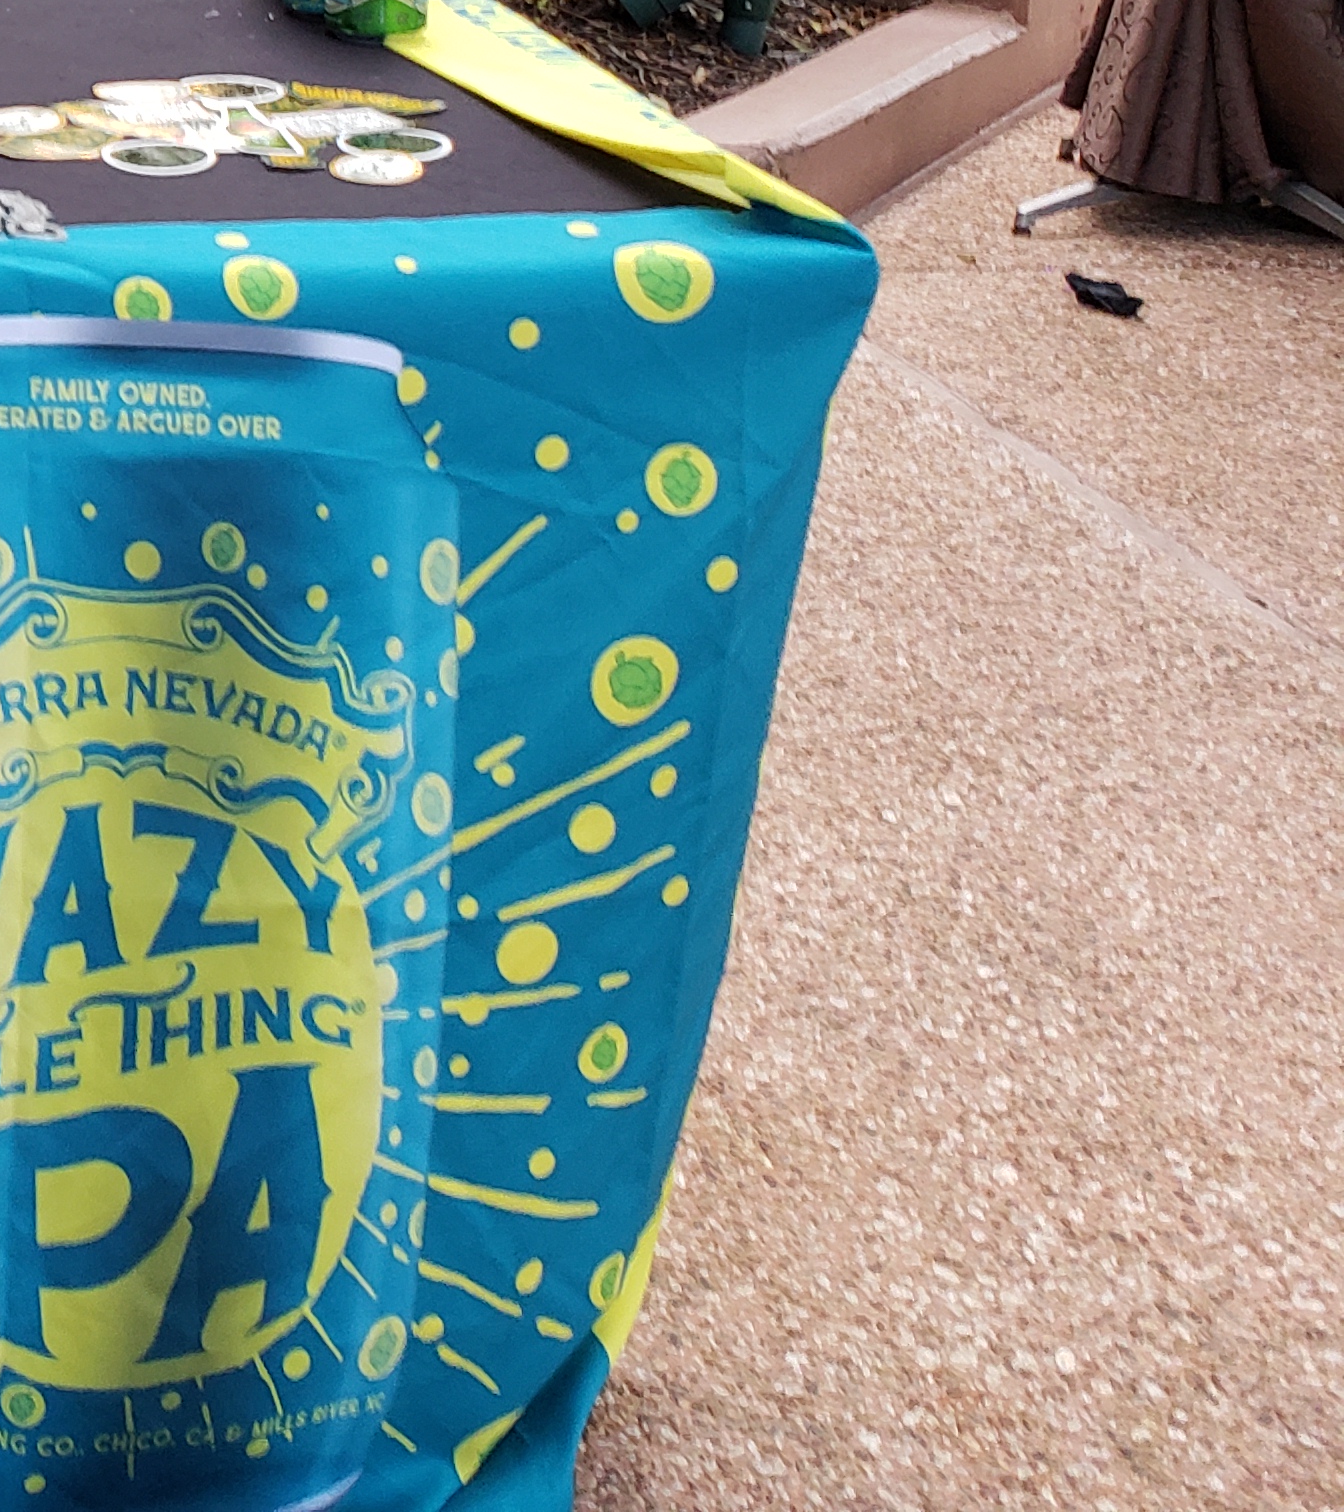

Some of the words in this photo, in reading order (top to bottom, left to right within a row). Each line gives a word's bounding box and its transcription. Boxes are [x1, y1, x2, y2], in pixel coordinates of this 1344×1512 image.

[28, 375, 110, 404] FAMILY
[88, 406, 110, 432] &
[116, 408, 211, 437] ARGUED
[217, 414, 282, 440] OVER
